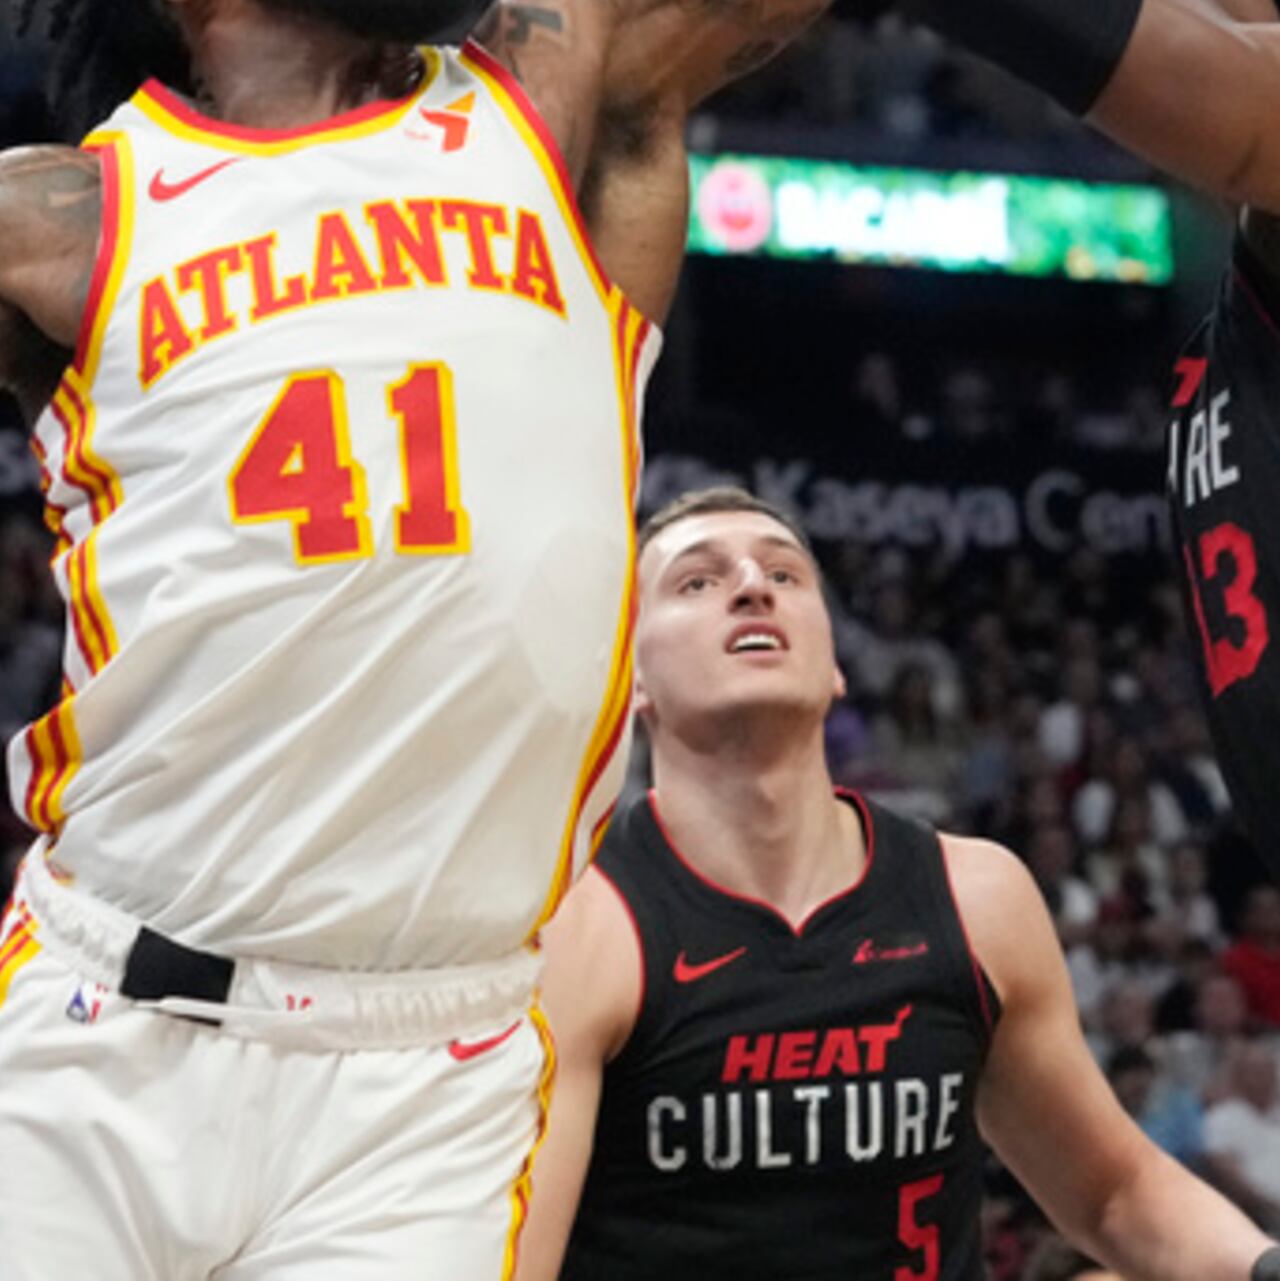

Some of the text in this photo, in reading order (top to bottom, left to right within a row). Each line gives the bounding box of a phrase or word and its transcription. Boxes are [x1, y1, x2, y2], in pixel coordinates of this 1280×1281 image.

[137, 198, 569, 392] ATLANTA
[226, 360, 471, 567] 41
[1168, 388, 1241, 508] RE
[1026, 468, 1176, 554] Cen
[1183, 521, 1269, 699] 3
[722, 1004, 912, 1083] HEAT
[646, 1072, 964, 1170] CULTURE
[894, 1173, 945, 1281] 5
